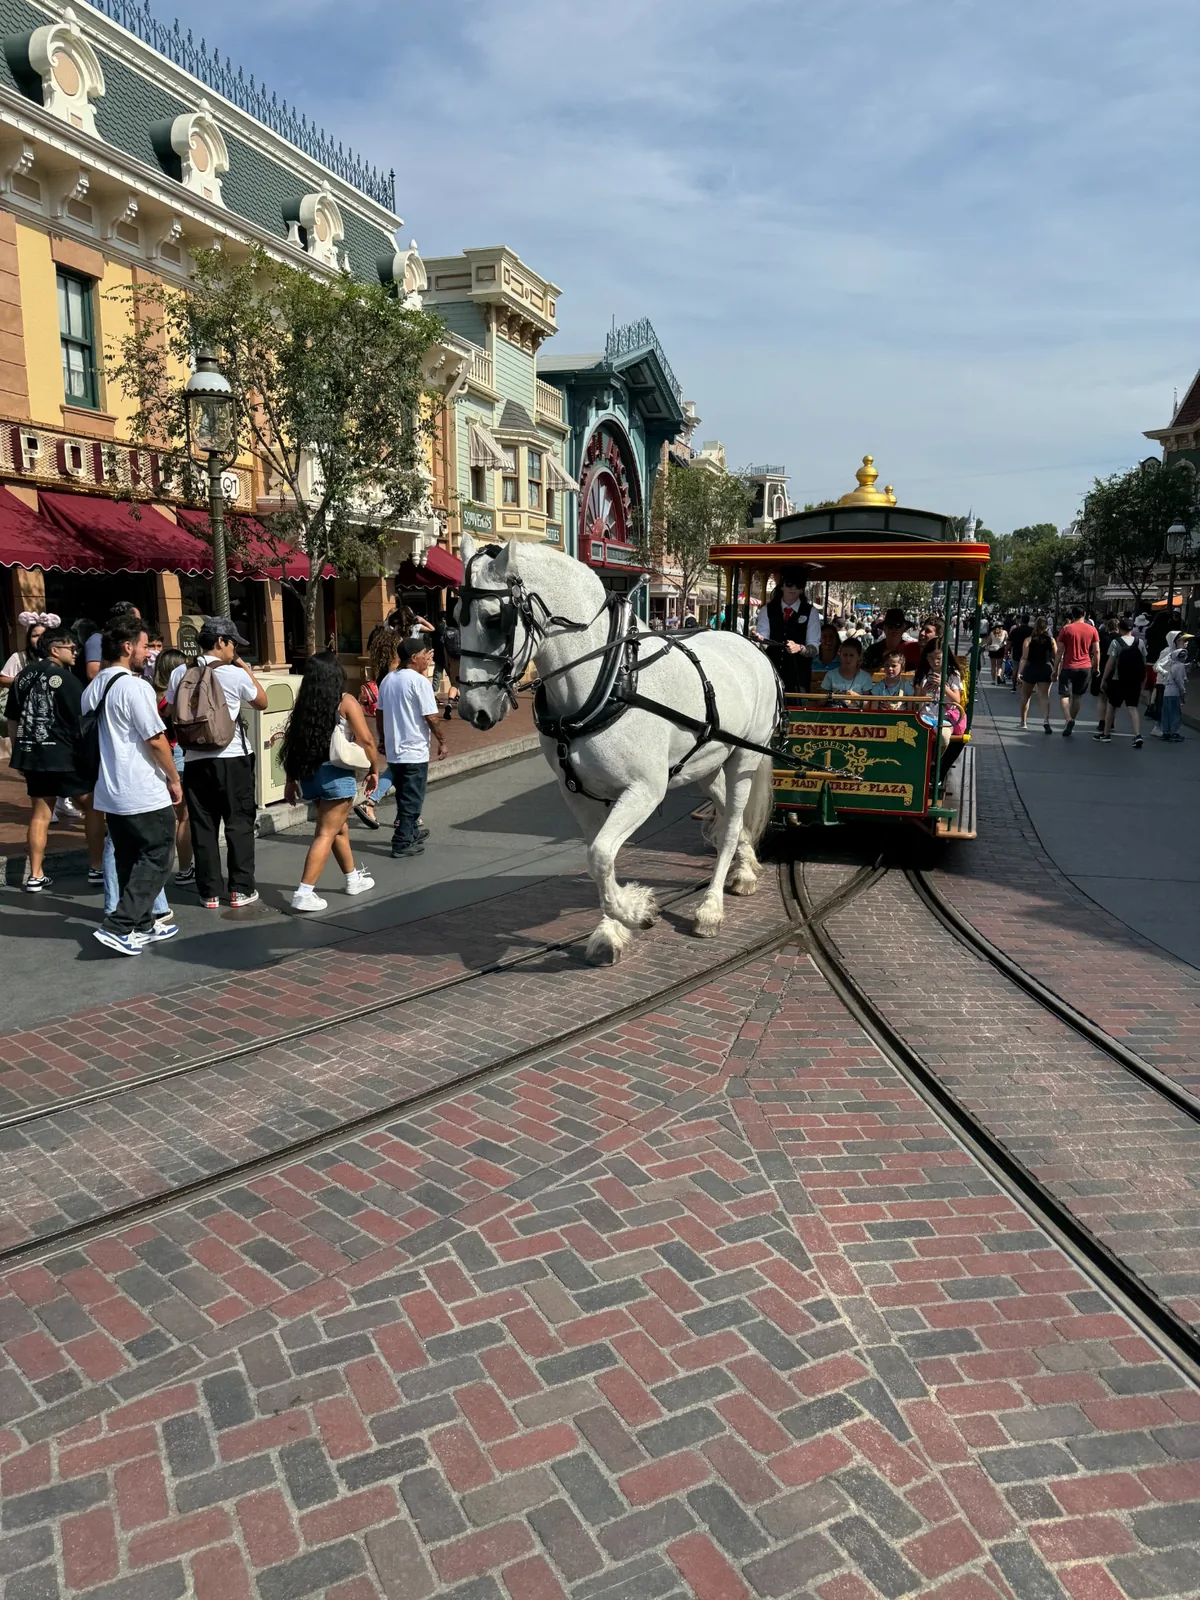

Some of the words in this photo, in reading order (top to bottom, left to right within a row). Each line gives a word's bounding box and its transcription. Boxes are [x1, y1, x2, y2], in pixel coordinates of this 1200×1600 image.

[788, 723, 887, 738] ISNEYLAND
[811, 740, 849, 750] STREET
[822, 749, 833, 768] 1
[791, 779, 818, 789] MAIN
[829, 781, 862, 791] TREET
[869, 783, 907, 794] PLAZA
